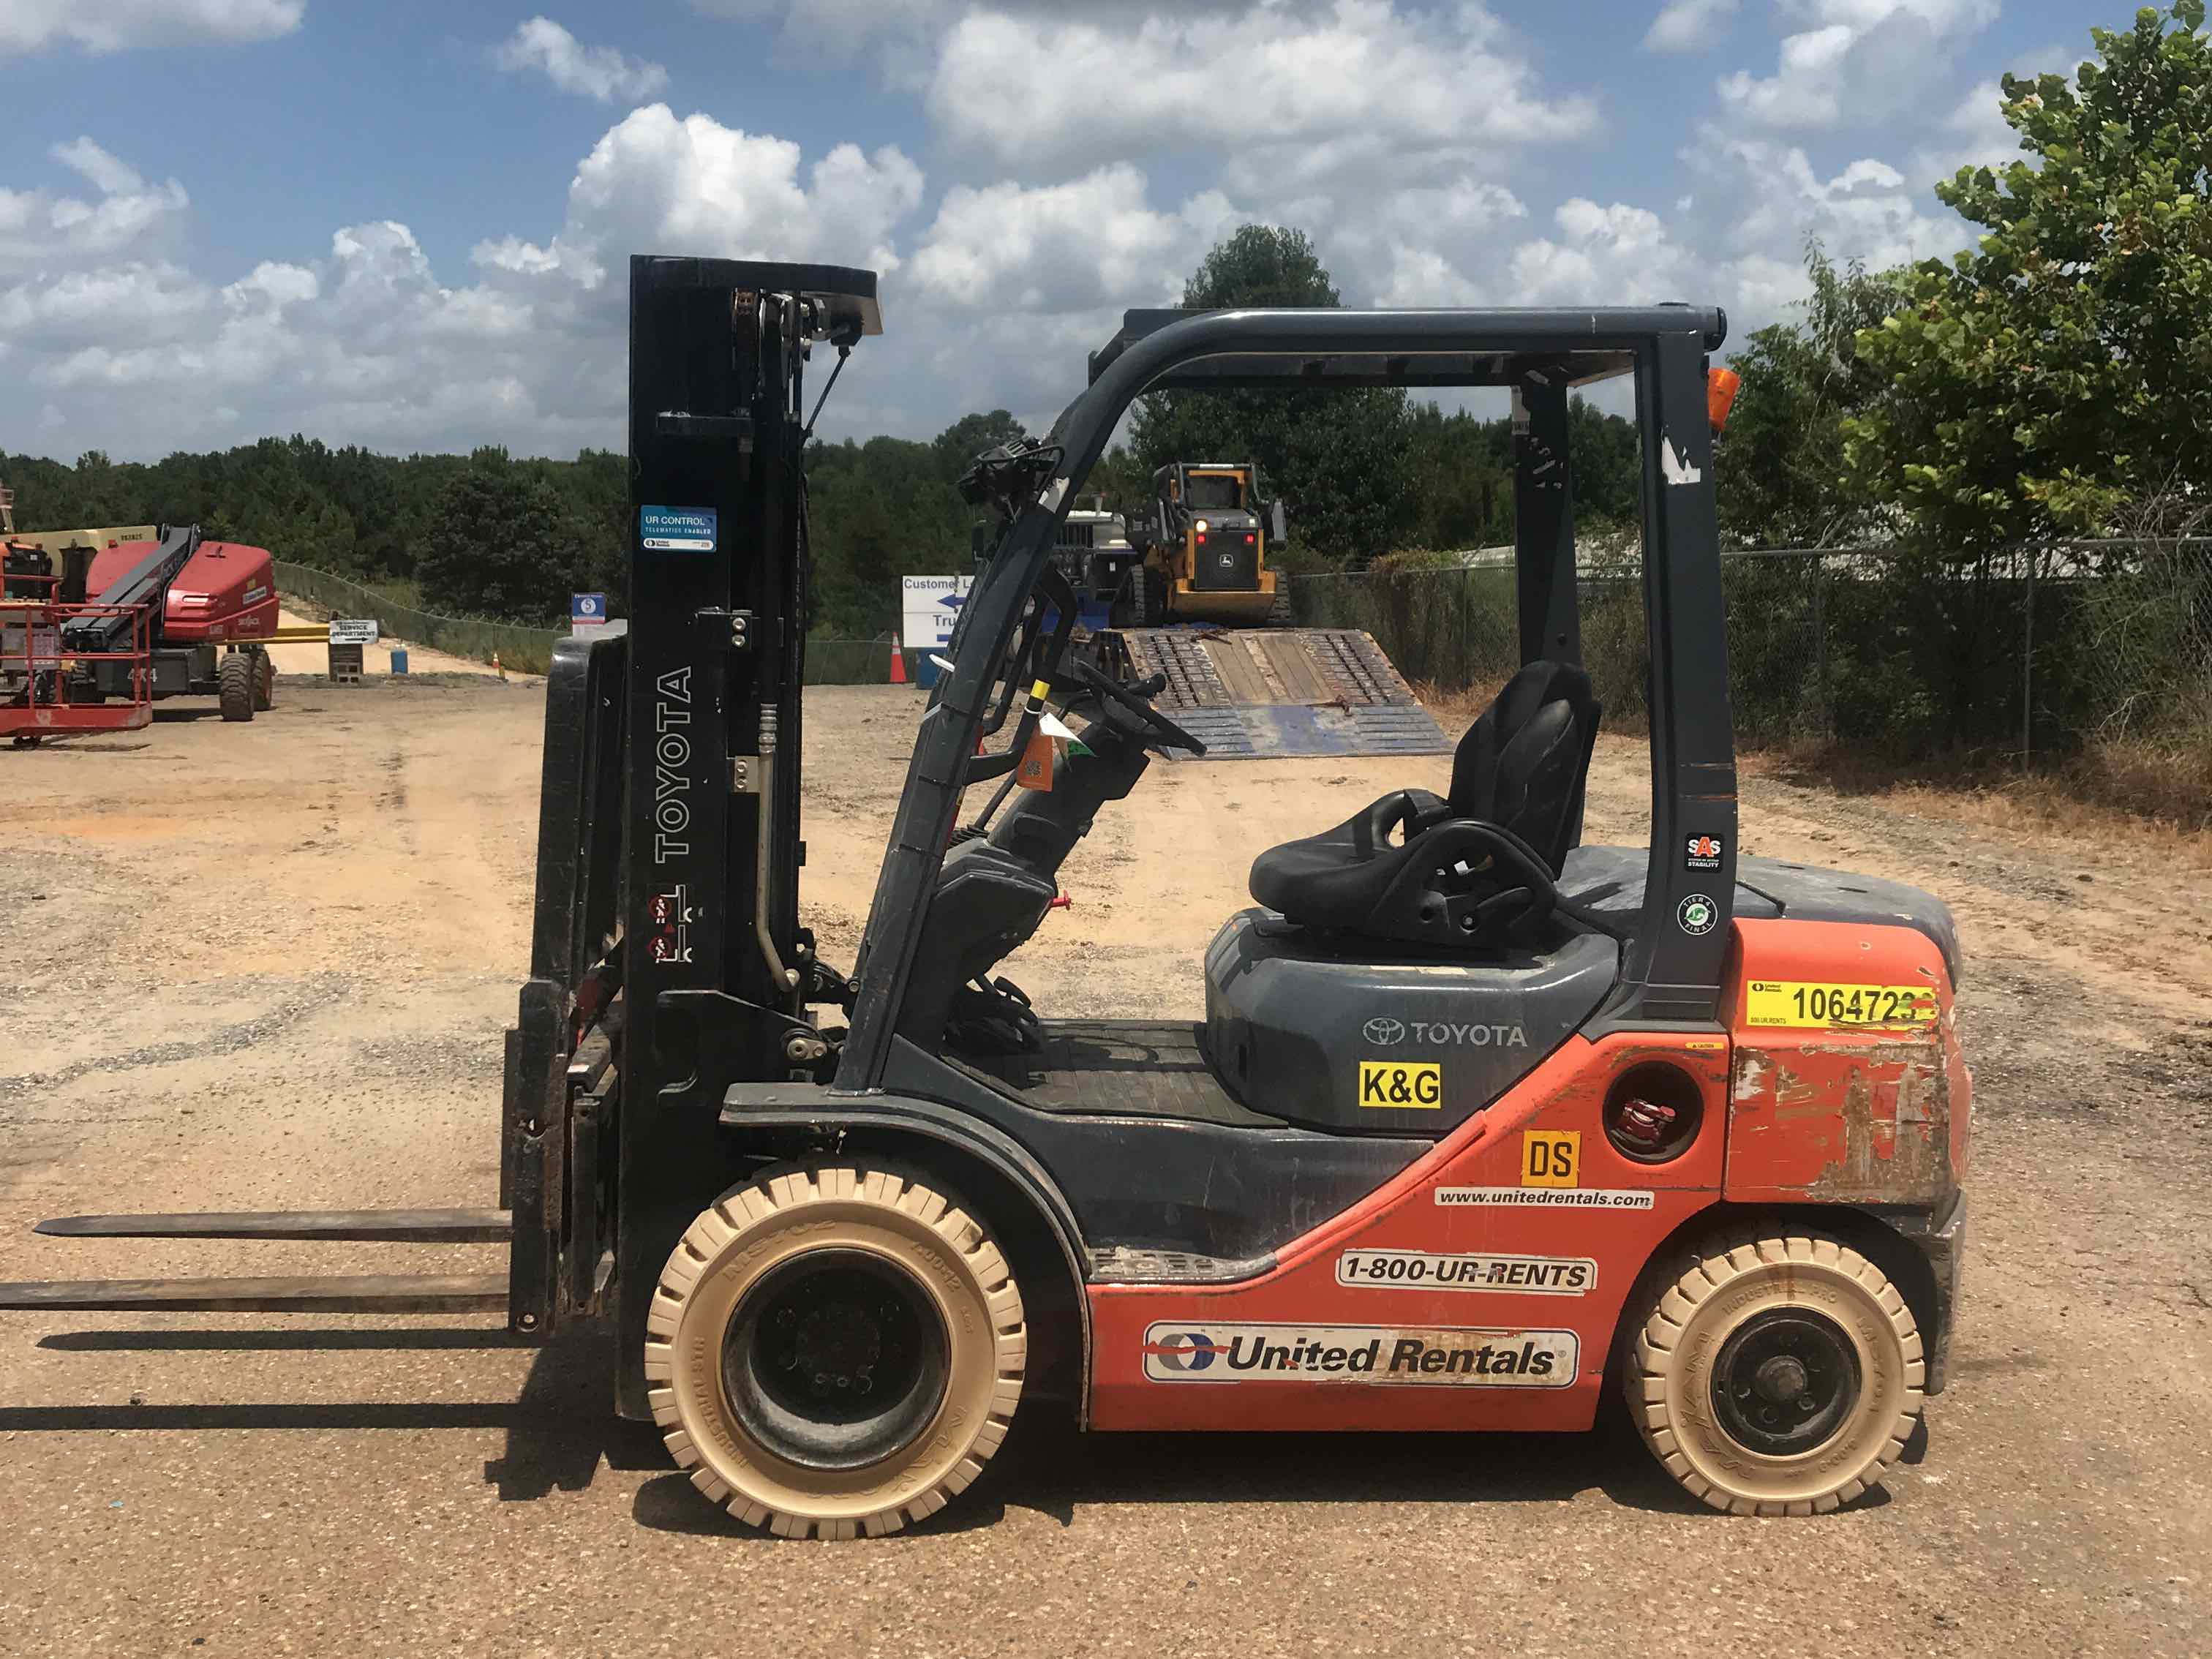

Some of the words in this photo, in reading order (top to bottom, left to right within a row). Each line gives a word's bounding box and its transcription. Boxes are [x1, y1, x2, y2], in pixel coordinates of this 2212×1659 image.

[645, 516, 659, 524] UR
[661, 516, 705, 526] CONTROL
[904, 579, 960, 590] Customer
[655, 666, 691, 864] TOYOTA
[1688, 836, 1721, 857] SAS
[1683, 897, 1704, 908] TIER
[1684, 922, 1712, 933] FINAL
[1410, 1022, 1528, 1047] TOYOTA
[1364, 1068, 1440, 1105] K&G
[1530, 1140, 1573, 1178] DS
[1440, 1190, 1651, 1207] www.unitedrentals.com
[1347, 1257, 1587, 1287] 1-800-UR-RENTS
[1227, 1336, 1381, 1372] United
[1391, 1339, 1555, 1375] Rentals
